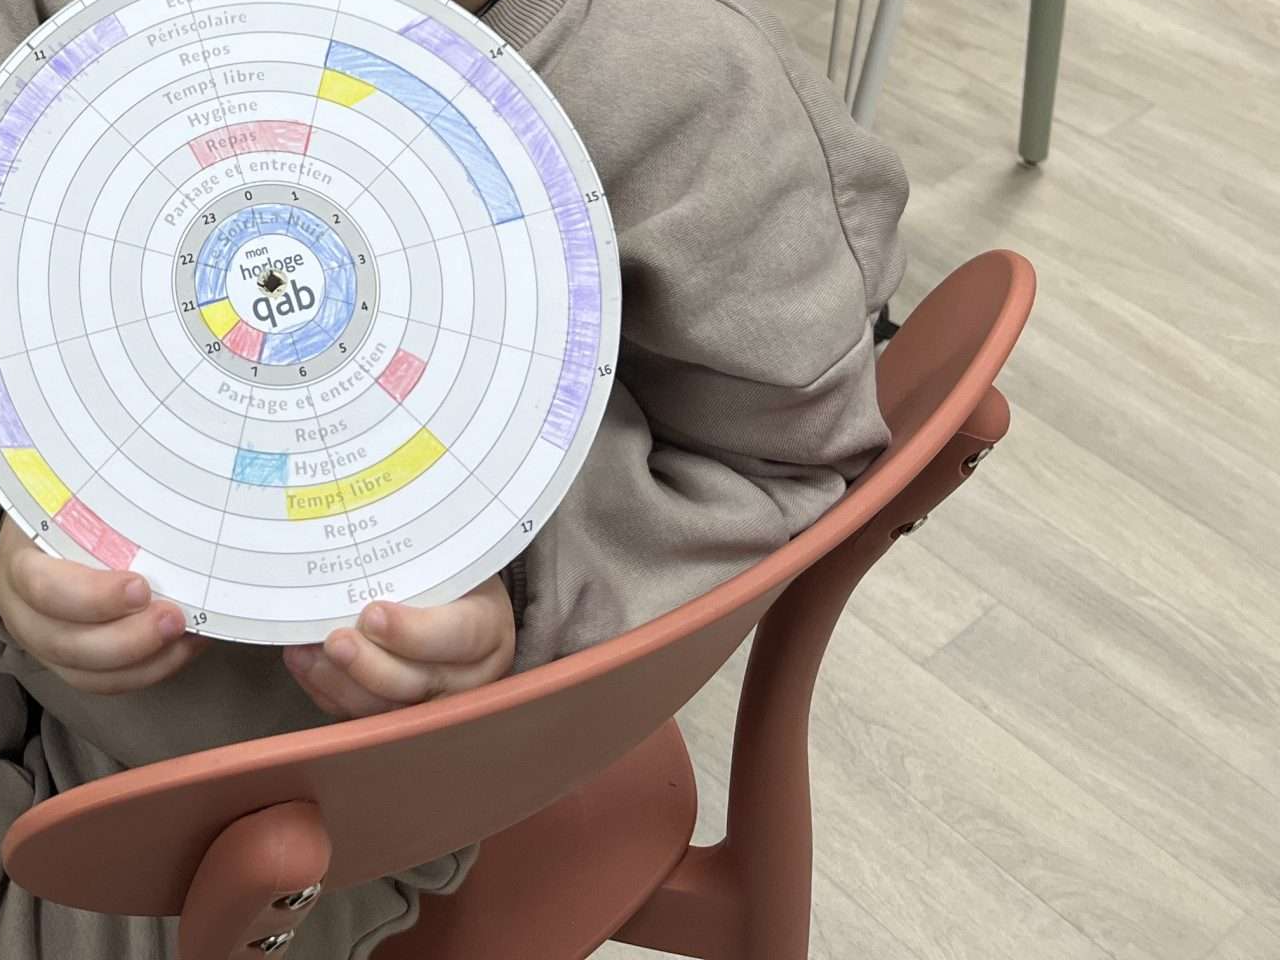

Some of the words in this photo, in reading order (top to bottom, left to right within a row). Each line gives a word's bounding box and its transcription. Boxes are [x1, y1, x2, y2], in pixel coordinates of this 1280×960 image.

[146, 10, 248, 47] Périscolaire
[33, 50, 47, 61] 11
[178, 43, 231, 67] Repos
[489, 46, 503, 59] 14
[162, 77, 217, 106] Temps
[223, 68, 265, 86] libre
[187, 97, 258, 128] Hygiène
[205, 130, 257, 153] Repas
[164, 175, 220, 226] Partage
[224, 163, 244, 178] et
[249, 159, 333, 185] entretien
[244, 190, 253, 201] 0
[291, 191, 299, 201] 1
[585, 190, 600, 203] 15
[202, 212, 217, 225] 23
[332, 214, 341, 225] 2
[180, 253, 195, 265] 22
[245, 246, 269, 260] mon
[359, 254, 366, 265] 3
[240, 252, 305, 281] horloge
[182, 300, 196, 313] 21
[252, 279, 316, 328] qab
[360, 301, 369, 312] 4
[205, 341, 221, 355] 20
[338, 342, 347, 354] 5
[250, 366, 258, 377] 7
[299, 366, 308, 377] 6
[598, 364, 612, 377] 16
[217, 381, 288, 415] Partage
[296, 392, 315, 410] et
[321, 342, 387, 402] entretien
[295, 419, 349, 442] Repas
[294, 445, 368, 478] Hygiène
[287, 490, 345, 510] Temps
[351, 470, 393, 497] libre
[41, 520, 49, 532] 8
[324, 514, 379, 540] Repos
[521, 519, 534, 533] 17
[307, 536, 414, 575] Périscolaire
[347, 579, 396, 604] École
[192, 612, 208, 626] 19
